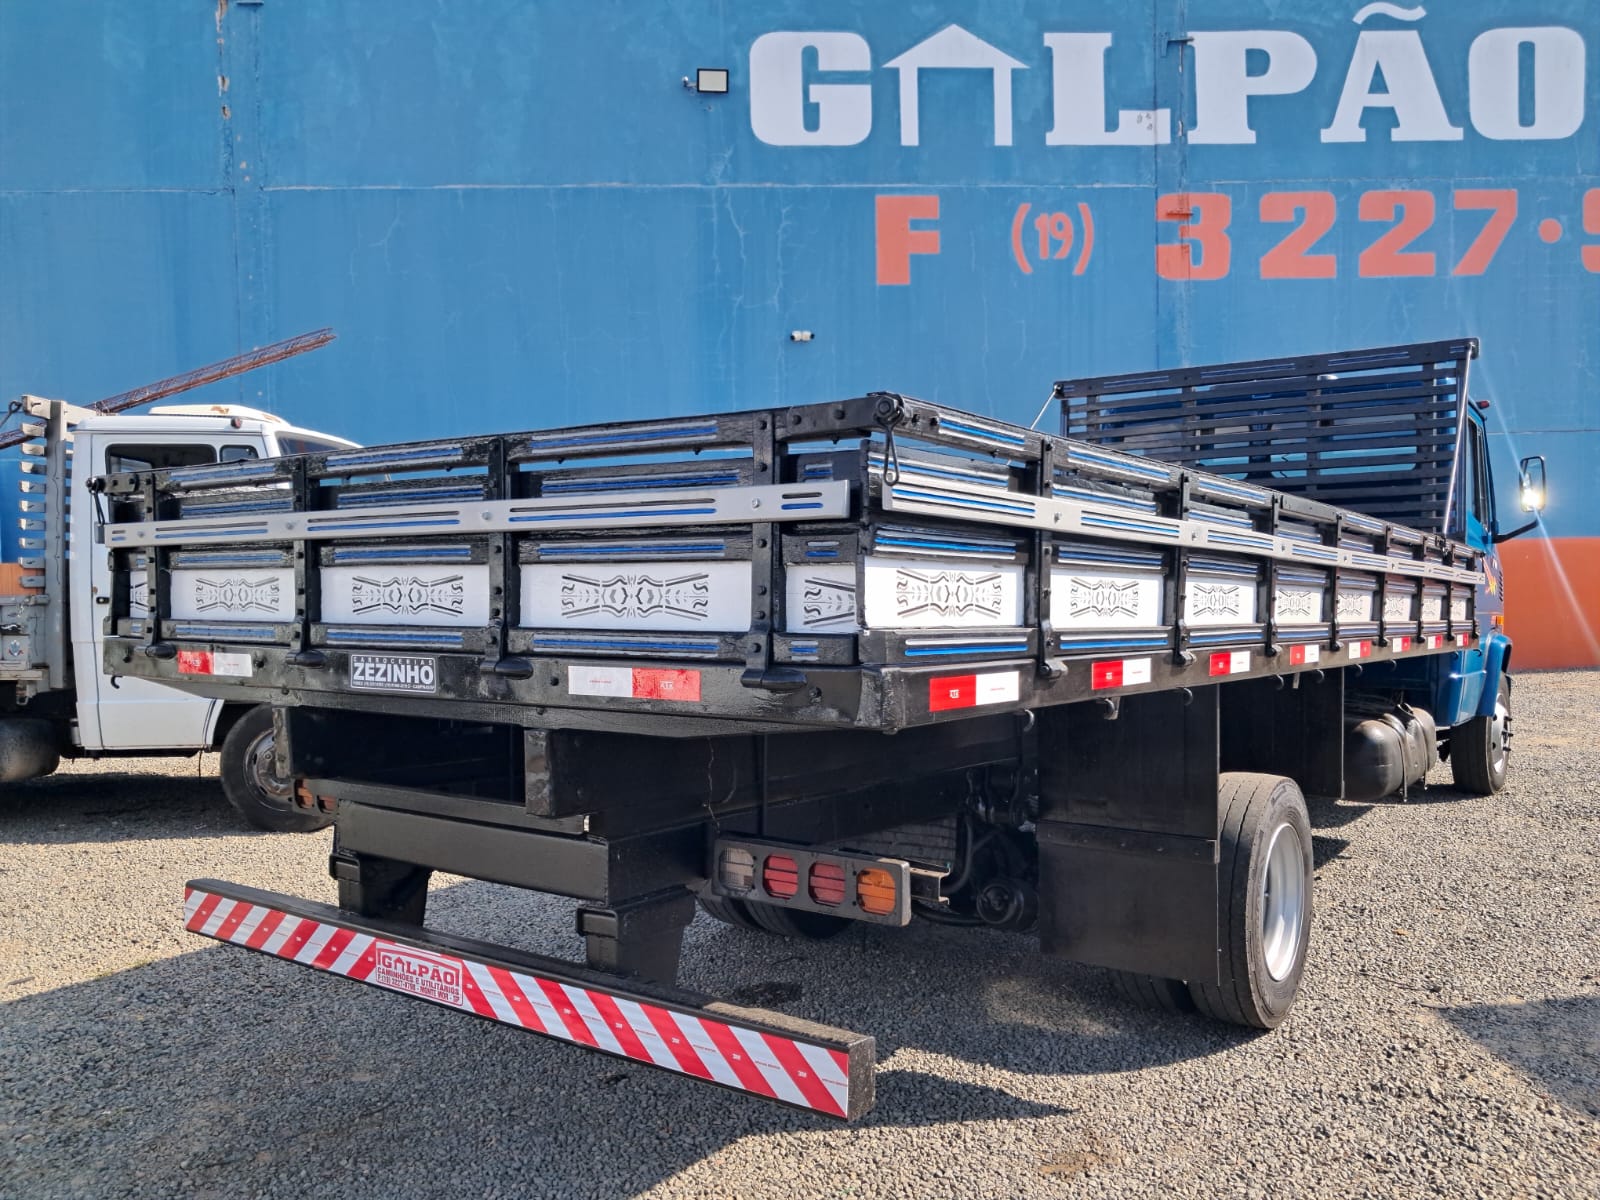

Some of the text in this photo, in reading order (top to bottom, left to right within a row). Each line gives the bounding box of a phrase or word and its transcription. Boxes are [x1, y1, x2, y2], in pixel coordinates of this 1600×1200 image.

[874, 194, 941, 286] F
[1011, 202, 1095, 275] (19)
[353, 662, 434, 685] ZEZINHO
